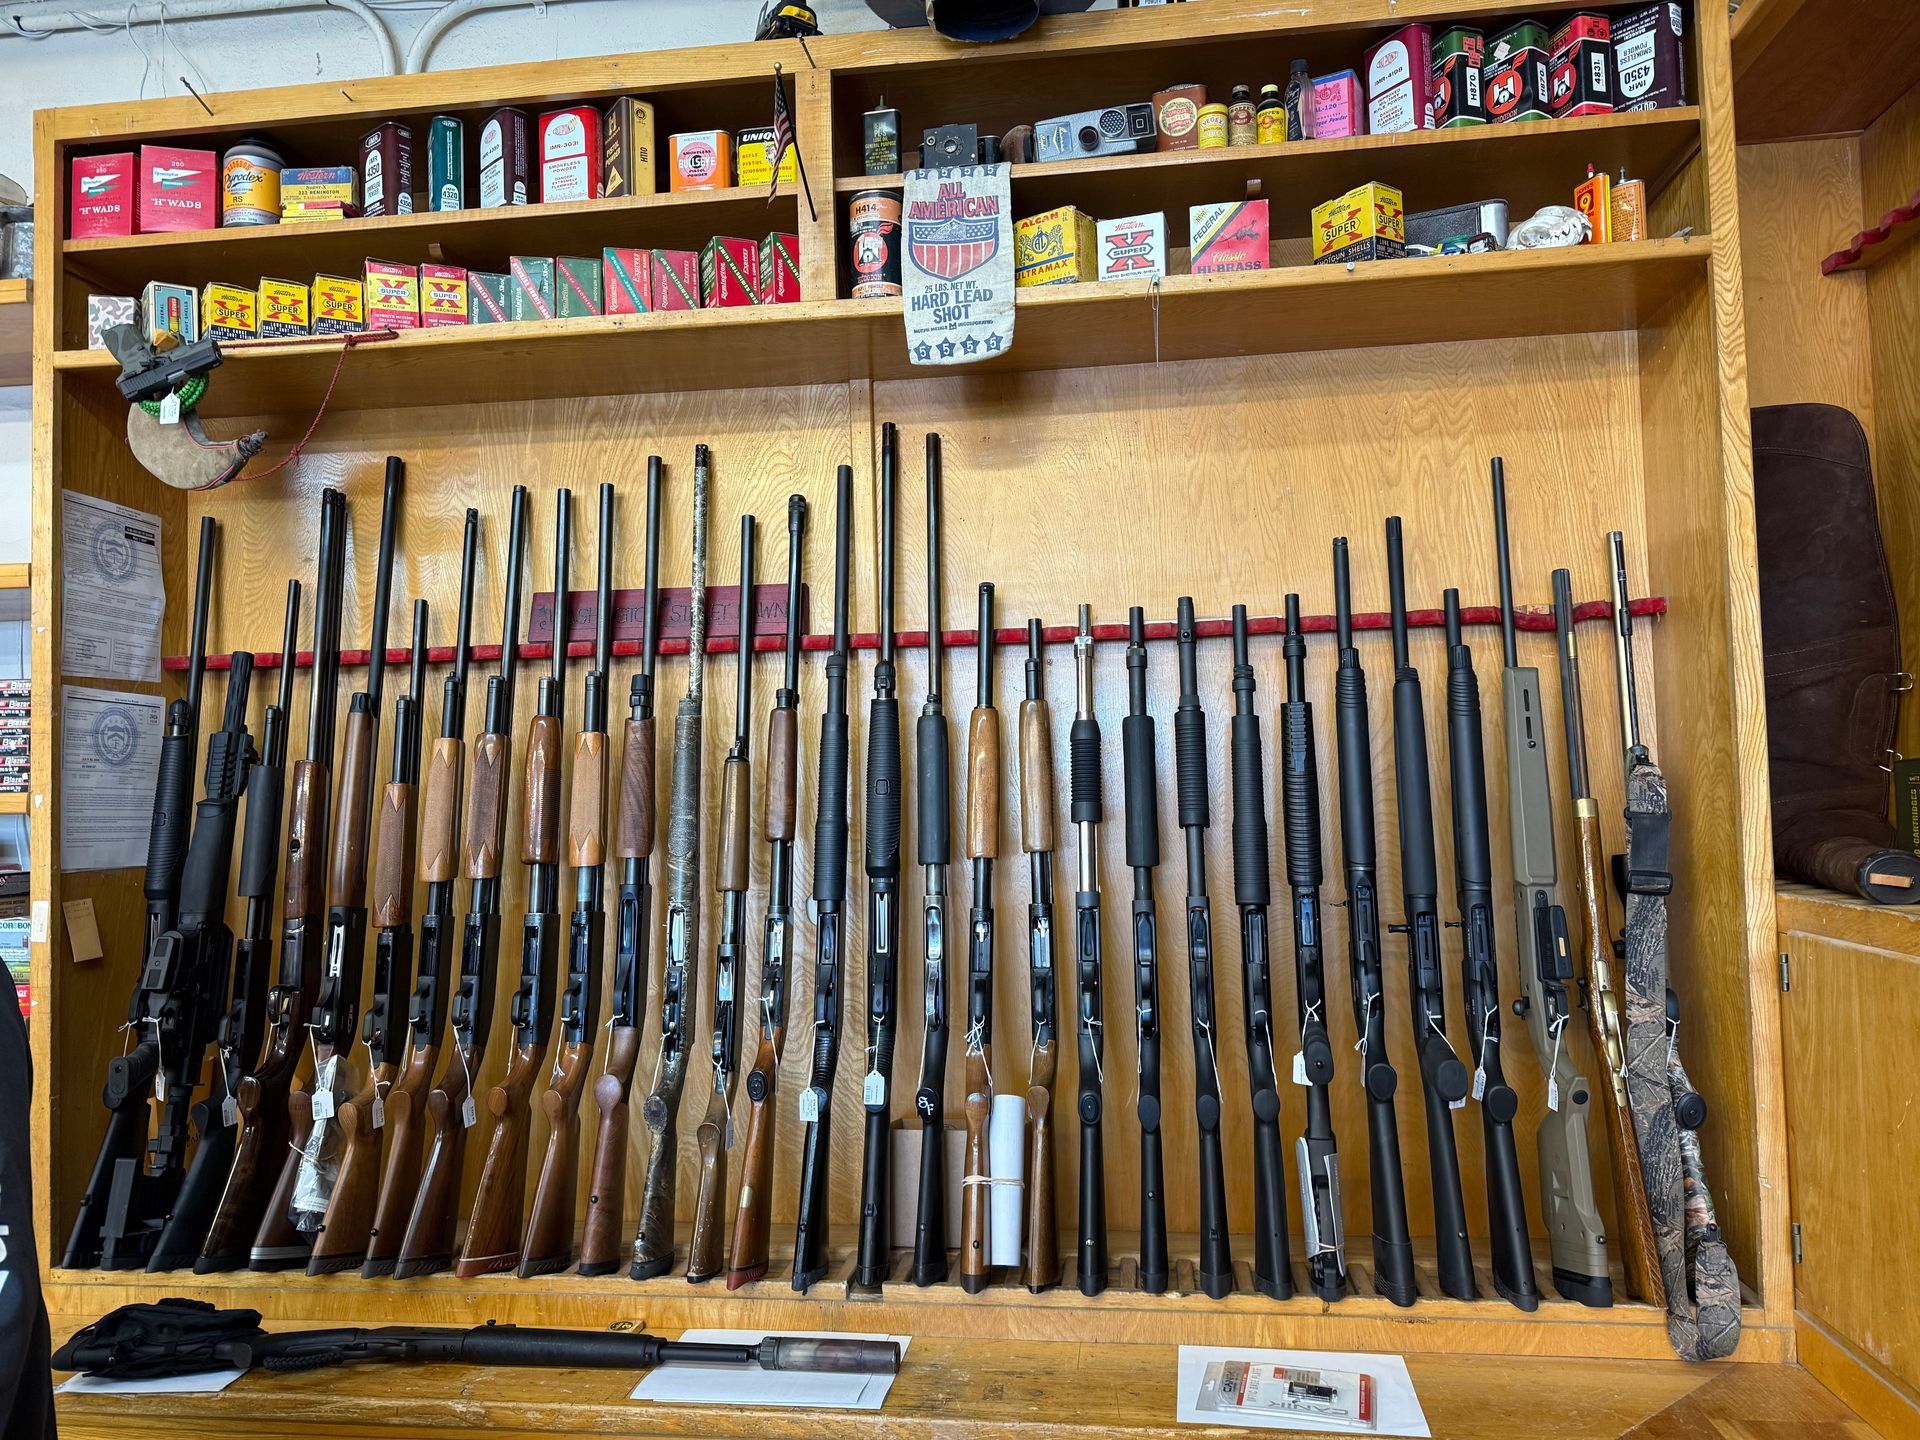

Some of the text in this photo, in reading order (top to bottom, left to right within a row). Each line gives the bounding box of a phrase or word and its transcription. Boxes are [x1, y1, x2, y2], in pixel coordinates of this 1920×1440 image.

[1623, 40, 1648, 56] POWDER
[1620, 46, 1652, 66] SMOKELESS
[1624, 65, 1650, 84] 4350
[1628, 80, 1646, 92] IMR
[742, 132, 776, 142] UNIQ
[550, 140, 579, 150] IMR-3031
[368, 155, 378, 165] IMR
[548, 160, 581, 170] SMOKELESS
[678, 156, 716, 168] BULLSEYE
[367, 162, 380, 178] 4350
[919, 168, 925, 178] 5
[988, 163, 994, 174] 5
[296, 170, 336, 180] Western
[224, 172, 264, 192] Pyrodex
[442, 190, 458, 199] 4320
[938, 182, 966, 201] ALL
[92, 204, 120, 214] WADS
[167, 200, 202, 209] WADS
[400, 199, 412, 208] 4350
[908, 195, 999, 220] AMERICAN
[1580, 192, 1591, 214] 9
[856, 204, 878, 215] H414
[1020, 212, 1059, 230] ALCAN
[1115, 222, 1145, 232] Western
[1193, 207, 1225, 243] FEDERAL
[1379, 215, 1400, 229] SUPER
[1325, 220, 1356, 241] SUPER
[776, 242, 788, 258] CRIMP
[1113, 247, 1147, 256] SUPER
[1348, 241, 1371, 256] SHELLS
[1212, 252, 1246, 264] Classic
[633, 253, 641, 282] Express
[1015, 259, 1068, 281] ULTRAMAX
[1197, 261, 1261, 274] HI-BRASS
[718, 245, 759, 305] NEW REMINGTON CRIMP
[380, 288, 407, 296] SUPER
[670, 272, 690, 301] REMINGTON
[925, 280, 979, 294] 25 LBS. NET WT.
[326, 301, 353, 311] SUPER
[912, 289, 993, 312] HARD LEAD
[218, 309, 246, 320] SUPER
[271, 304, 298, 313] SUPER
[932, 304, 972, 324] SHOT
[943, 343, 950, 355] 5
[966, 340, 973, 352] 5
[990, 337, 996, 349] 5
[920, 345, 927, 357] 5
[8, 700, 30, 708] Blazer
[8, 719, 30, 727] Blazer
[5, 757, 27, 765] Blazer
[1911, 789, 1919, 844] CARTRIDGES
